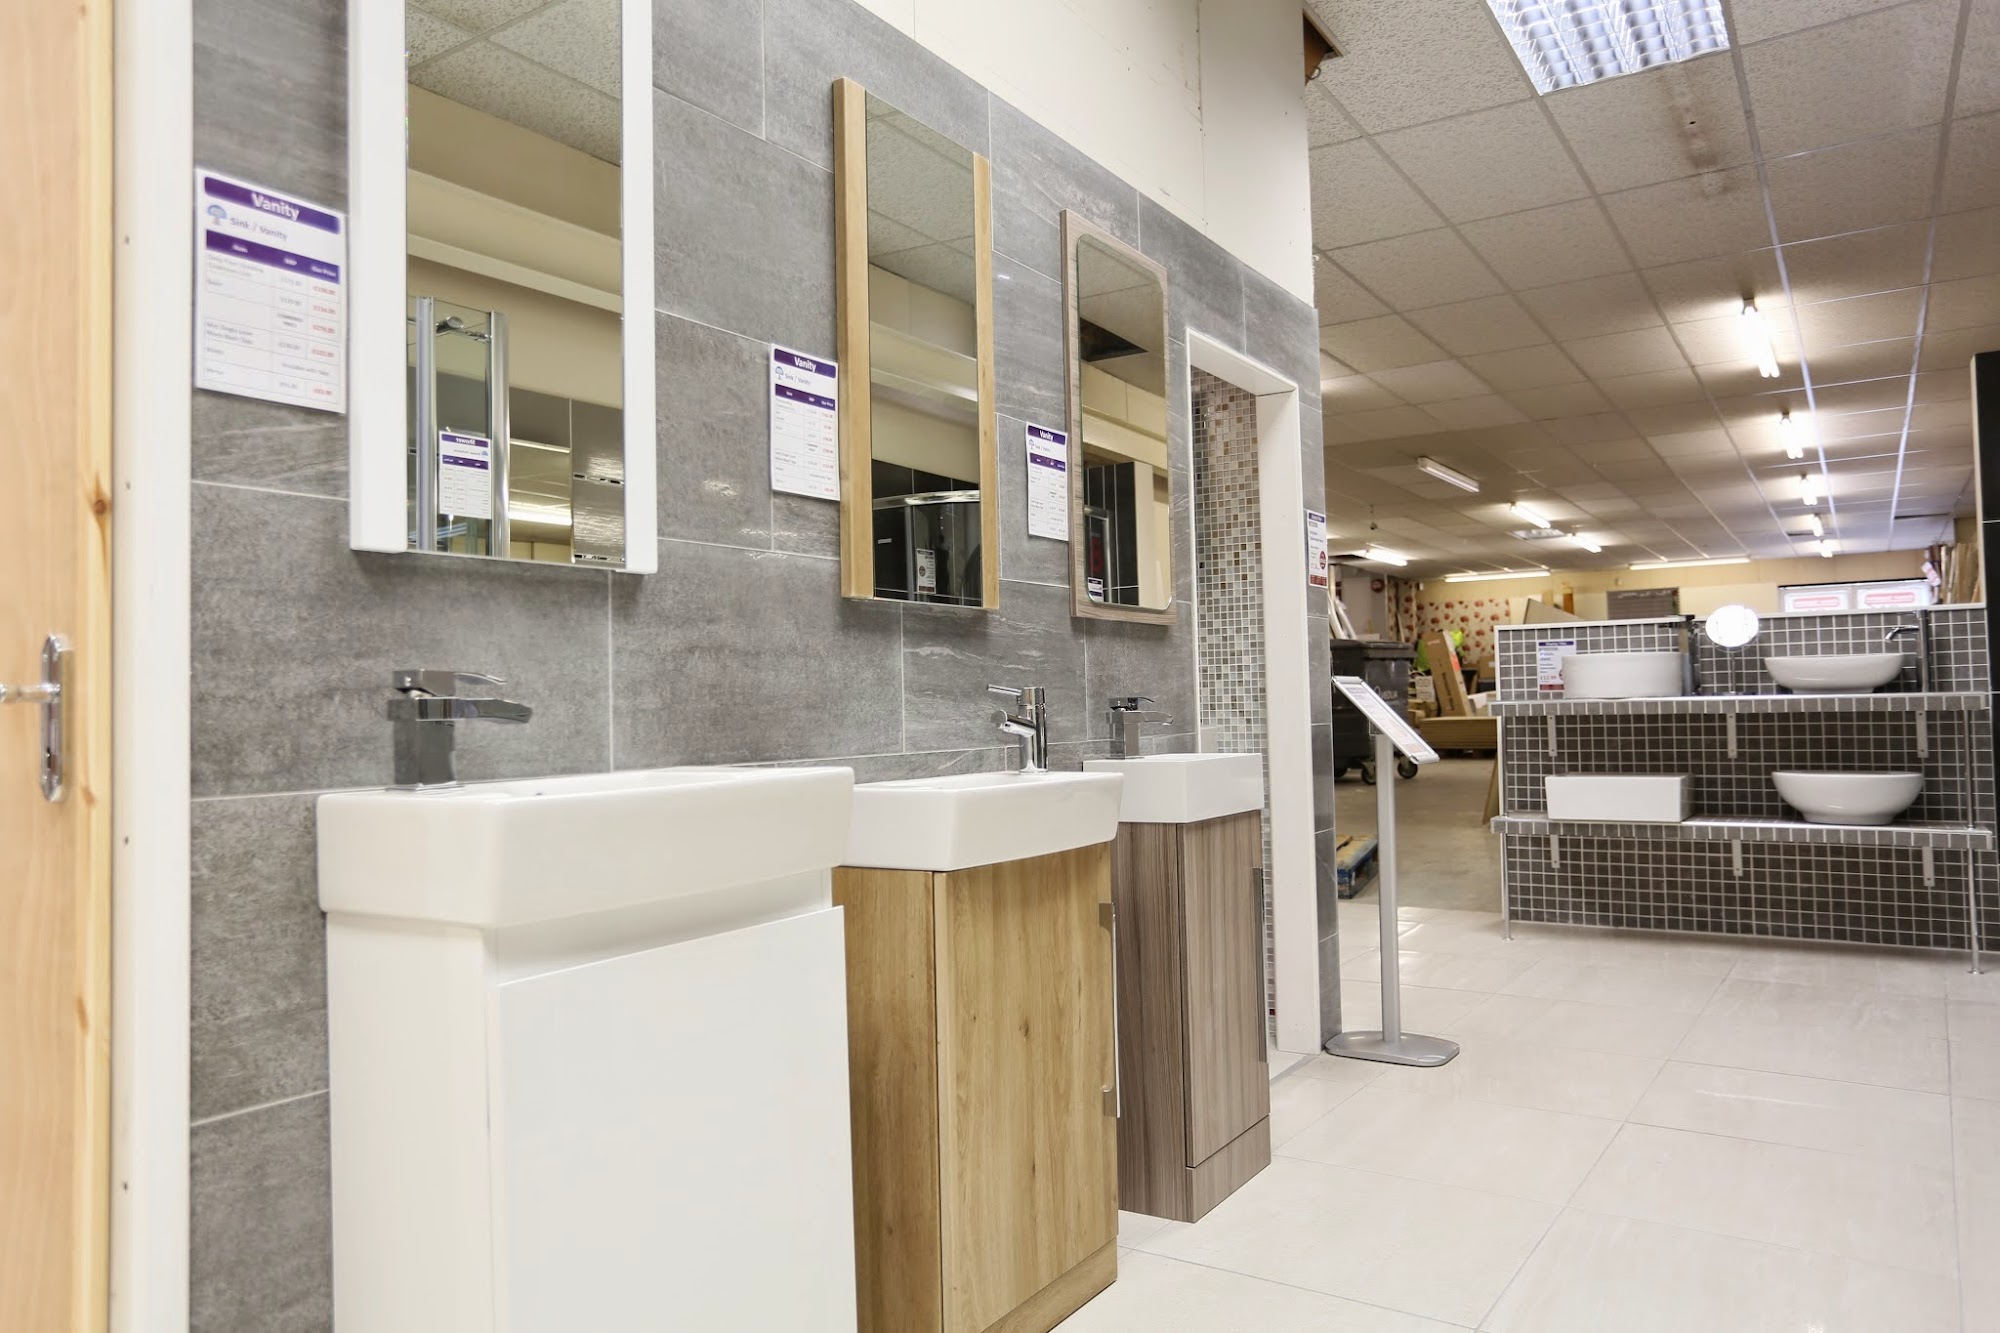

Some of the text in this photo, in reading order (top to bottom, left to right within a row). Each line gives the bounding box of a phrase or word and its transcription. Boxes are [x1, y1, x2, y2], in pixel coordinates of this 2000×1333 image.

[250, 192, 300, 221] Vanity
[229, 217, 250, 230] Sink
[259, 226, 288, 242] Vanity
[794, 356, 817, 373] Vanity
[1039, 429, 1053, 442] Vanity
